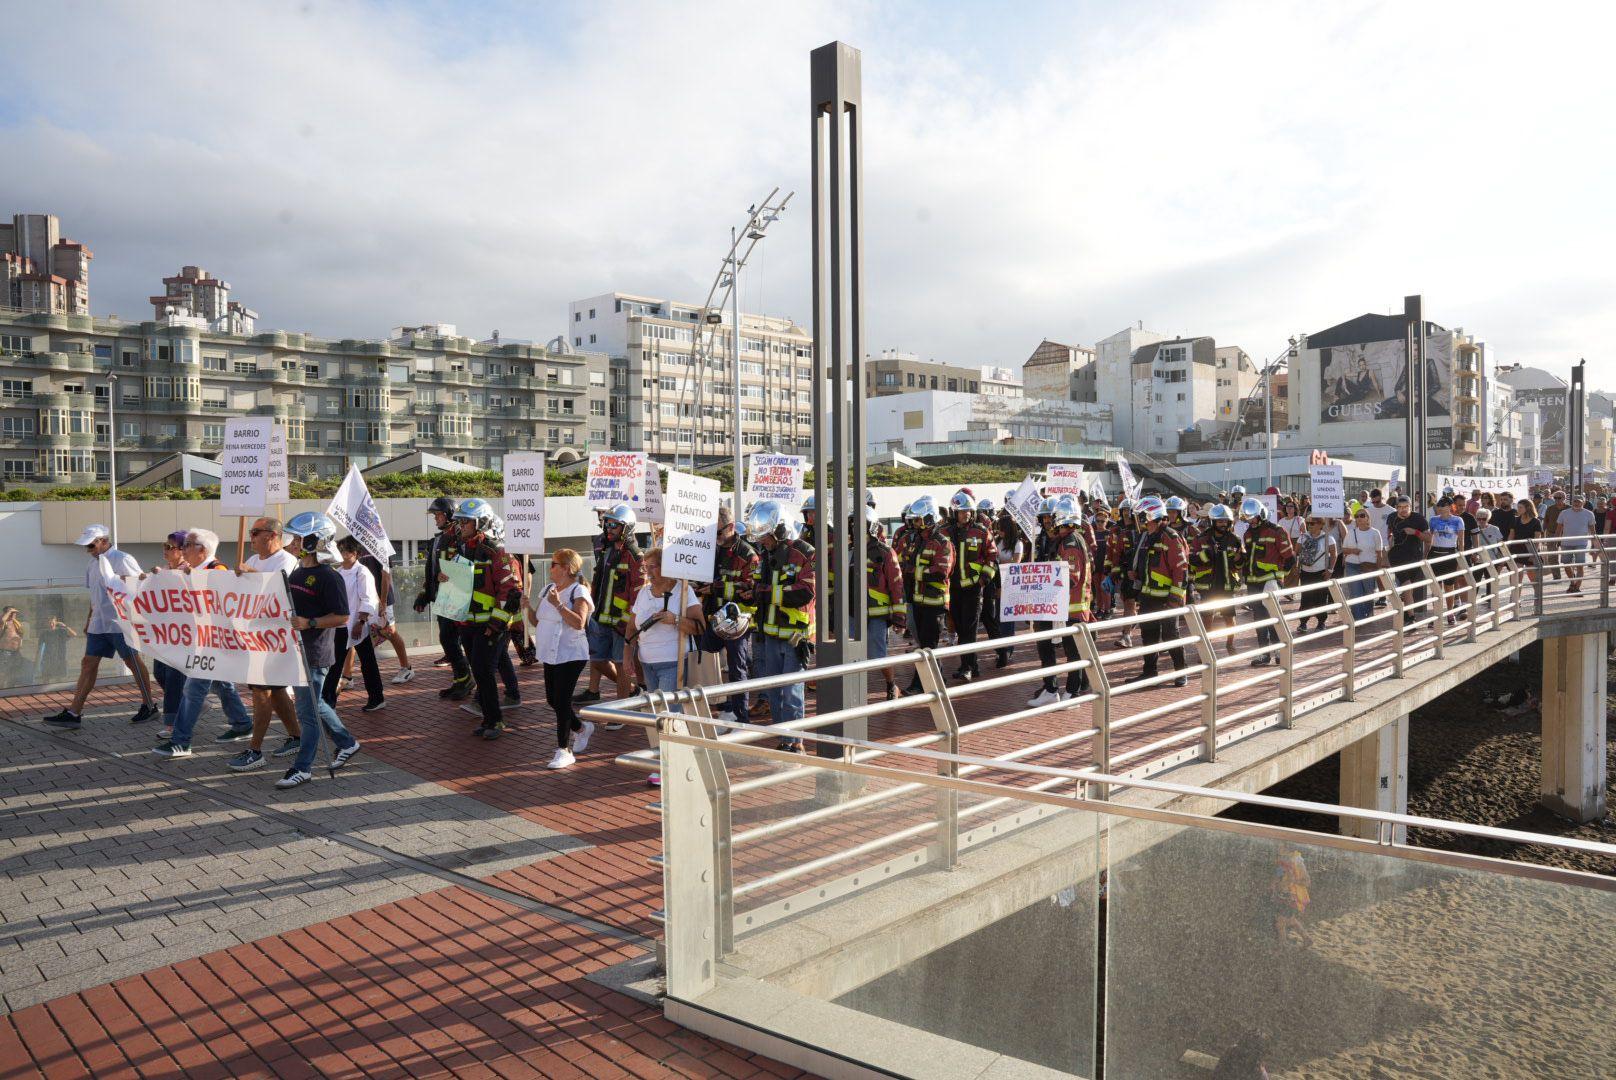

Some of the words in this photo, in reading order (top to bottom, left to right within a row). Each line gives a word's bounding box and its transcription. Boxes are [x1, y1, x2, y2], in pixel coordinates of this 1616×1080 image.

[1328, 402, 1382, 418] GUESS
[233, 429, 260, 438] BARRIO
[231, 455, 258, 464] UNIDOS
[599, 455, 636, 468] BOMBEROS
[248, 469, 263, 477] MÁS
[512, 468, 534, 477] BARRIO
[770, 467, 792, 476] FALTAN
[754, 474, 792, 486] BOMBEROS
[1443, 477, 1522, 488] ALCALDESA
[230, 485, 250, 494] LPGC
[507, 483, 539, 492] ATLÁNTICO
[678, 489, 707, 502] BARRIO
[512, 499, 535, 507] UNIDOS
[670, 504, 712, 519] ATLÁNTICO
[352, 520, 378, 546] SINDICAL
[513, 528, 530, 538] LPGC
[675, 521, 705, 534] UNIDOS
[668, 536, 694, 547] SOMOS
[695, 540, 711, 549] MÁS
[361, 536, 389, 566] BOMBERO
[674, 553, 697, 565] LPGC
[1009, 565, 1019, 574] EN
[1012, 576, 1020, 585] LA
[1022, 575, 1051, 584] ISLETA
[133, 588, 223, 615] NUESTRA
[1014, 603, 1058, 616] BOMBEROS
[132, 623, 149, 643] E
[152, 623, 192, 646] NOS
[185, 655, 215, 671] LPGC
